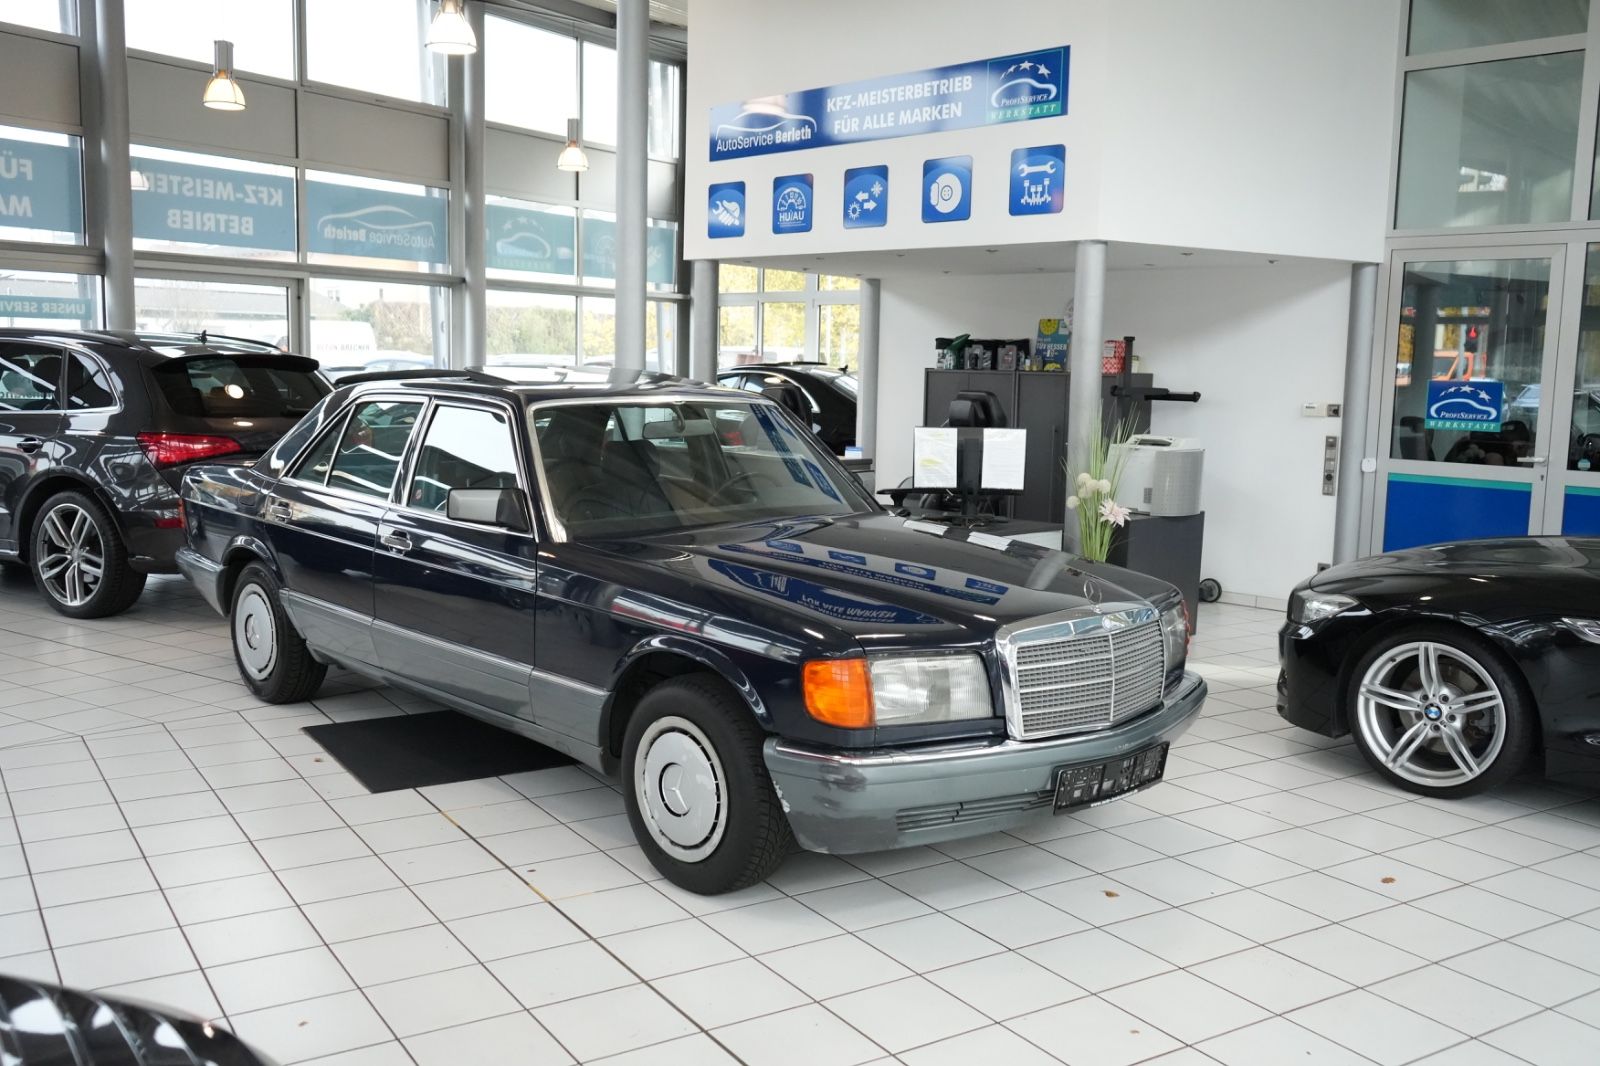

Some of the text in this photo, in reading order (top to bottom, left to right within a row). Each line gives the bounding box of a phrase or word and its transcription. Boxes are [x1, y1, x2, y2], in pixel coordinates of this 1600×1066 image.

[827, 75, 972, 112] KFZ-MEISTERBETRIEB
[834, 102, 962, 134] FÜR ALLE MARKEN
[991, 104, 1056, 119] WERKSTATT
[716, 125, 811, 152] AutoService Berleth
[779, 210, 805, 221] HU/AU
[1430, 421, 1496, 429] WERKSTATT
